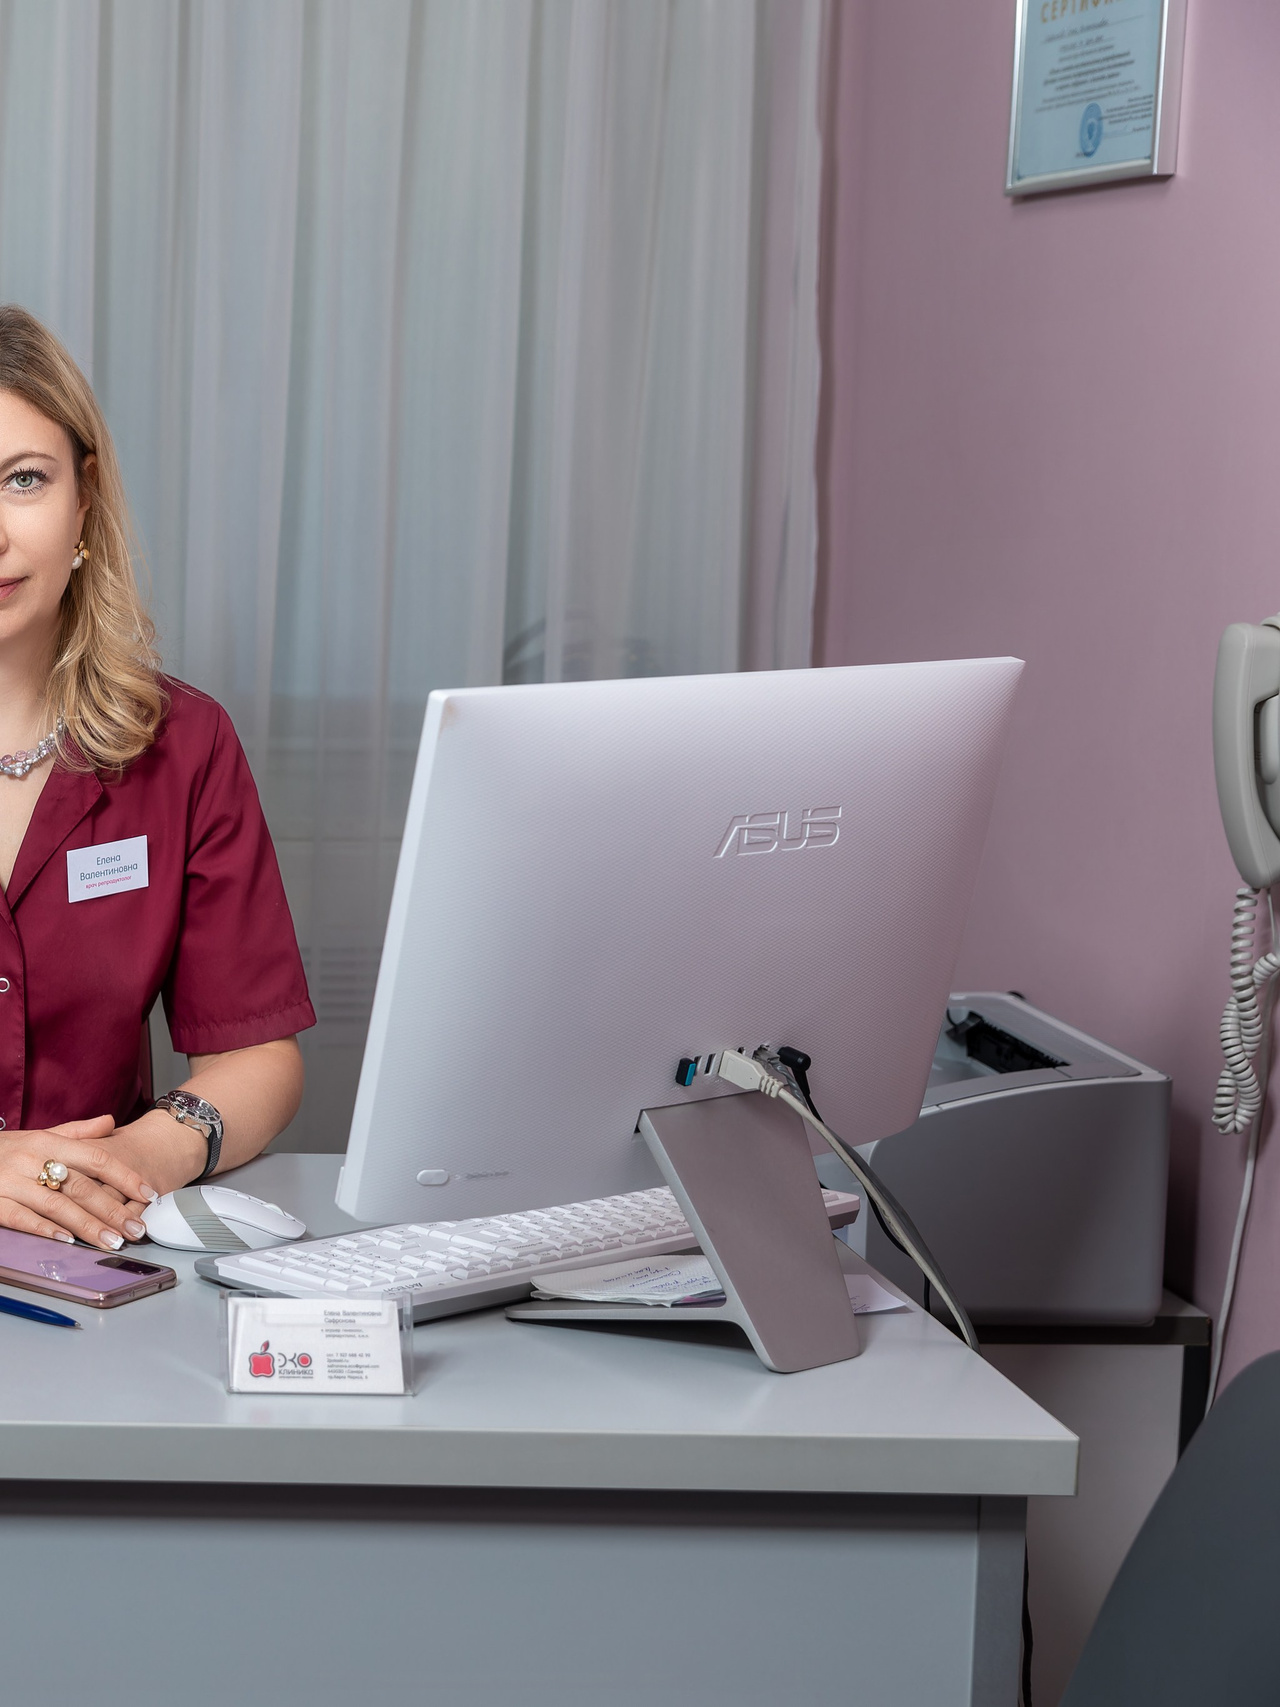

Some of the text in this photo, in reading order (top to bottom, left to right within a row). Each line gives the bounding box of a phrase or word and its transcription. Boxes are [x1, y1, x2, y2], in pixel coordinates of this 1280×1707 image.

[713, 806, 842, 858] ASUS
[96, 854, 121, 866] Елена
[80, 863, 138, 881] Валентиновна
[97, 875, 132, 887] репродуктолог
[278, 1352, 313, 1368] ЭКО
